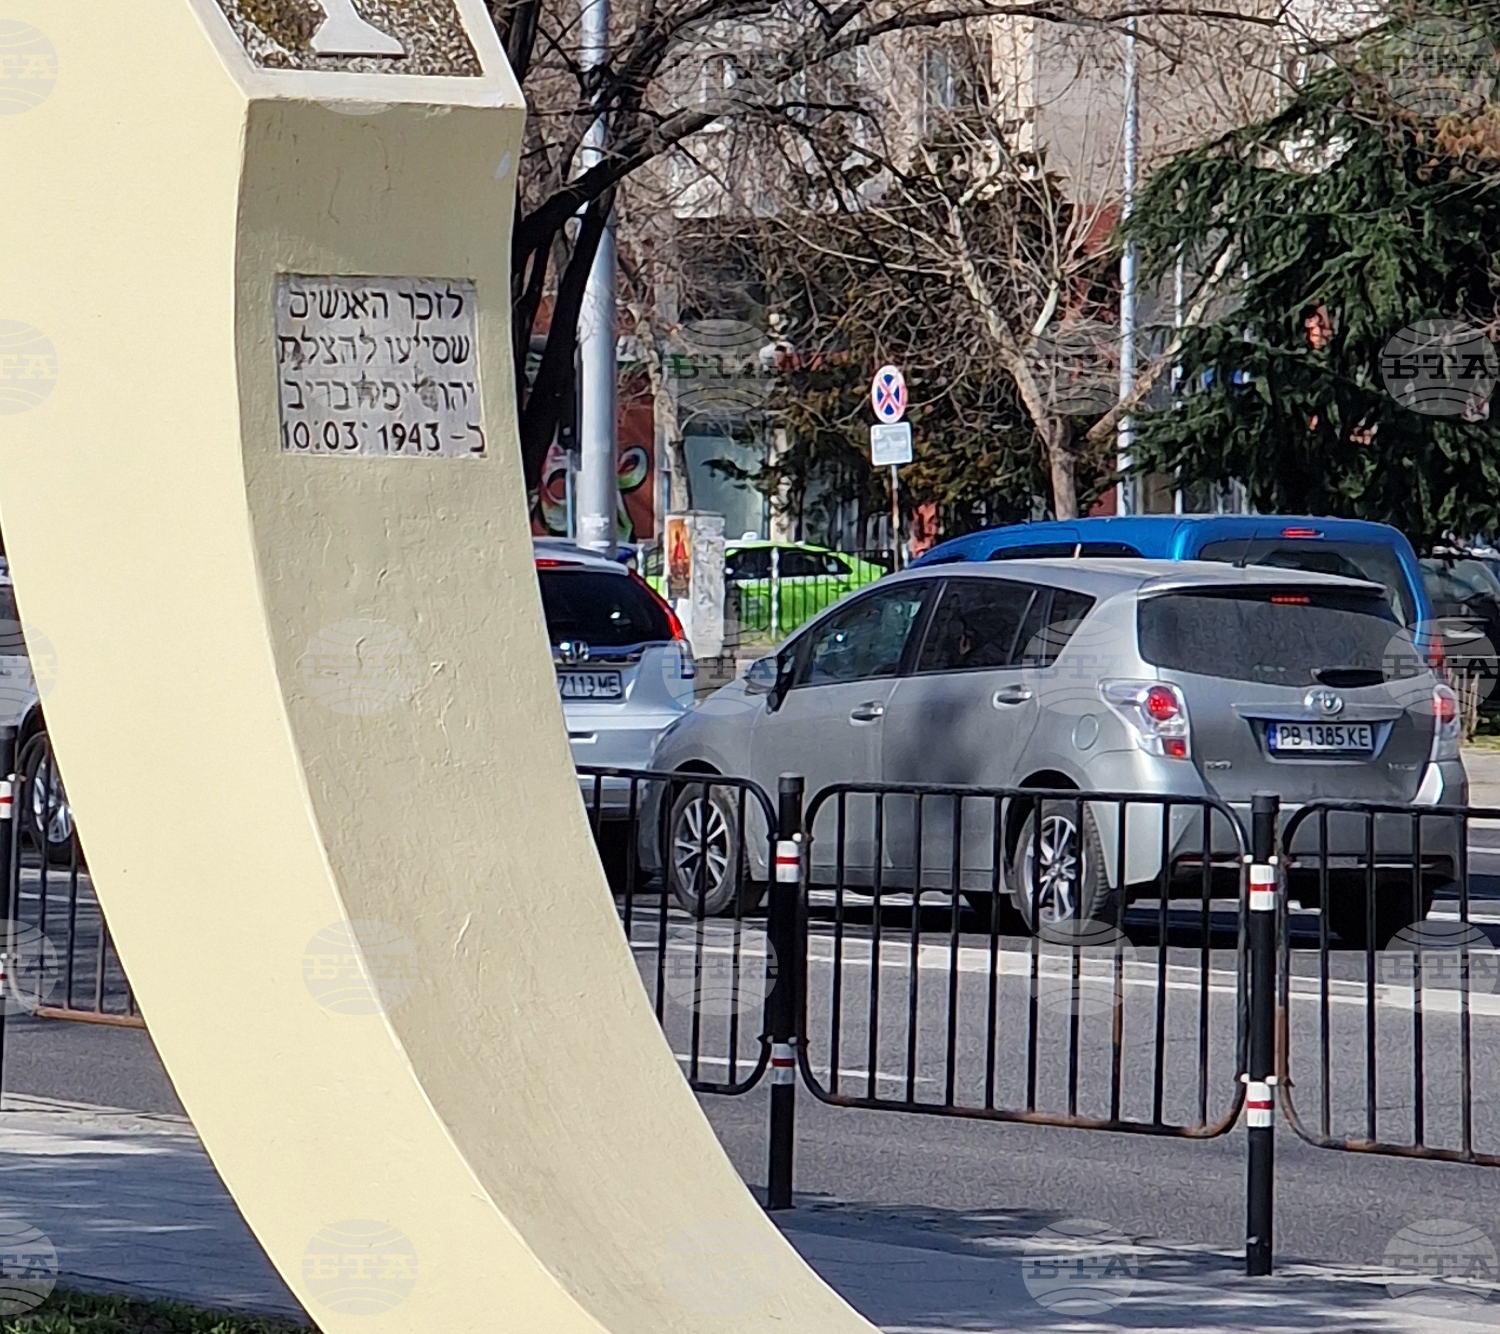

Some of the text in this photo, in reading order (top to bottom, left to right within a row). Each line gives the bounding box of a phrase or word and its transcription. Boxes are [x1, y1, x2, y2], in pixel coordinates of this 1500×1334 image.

[289, 283, 464, 320] לזכר האנשים
[1280, 726, 1369, 748] PB 1385 KE
